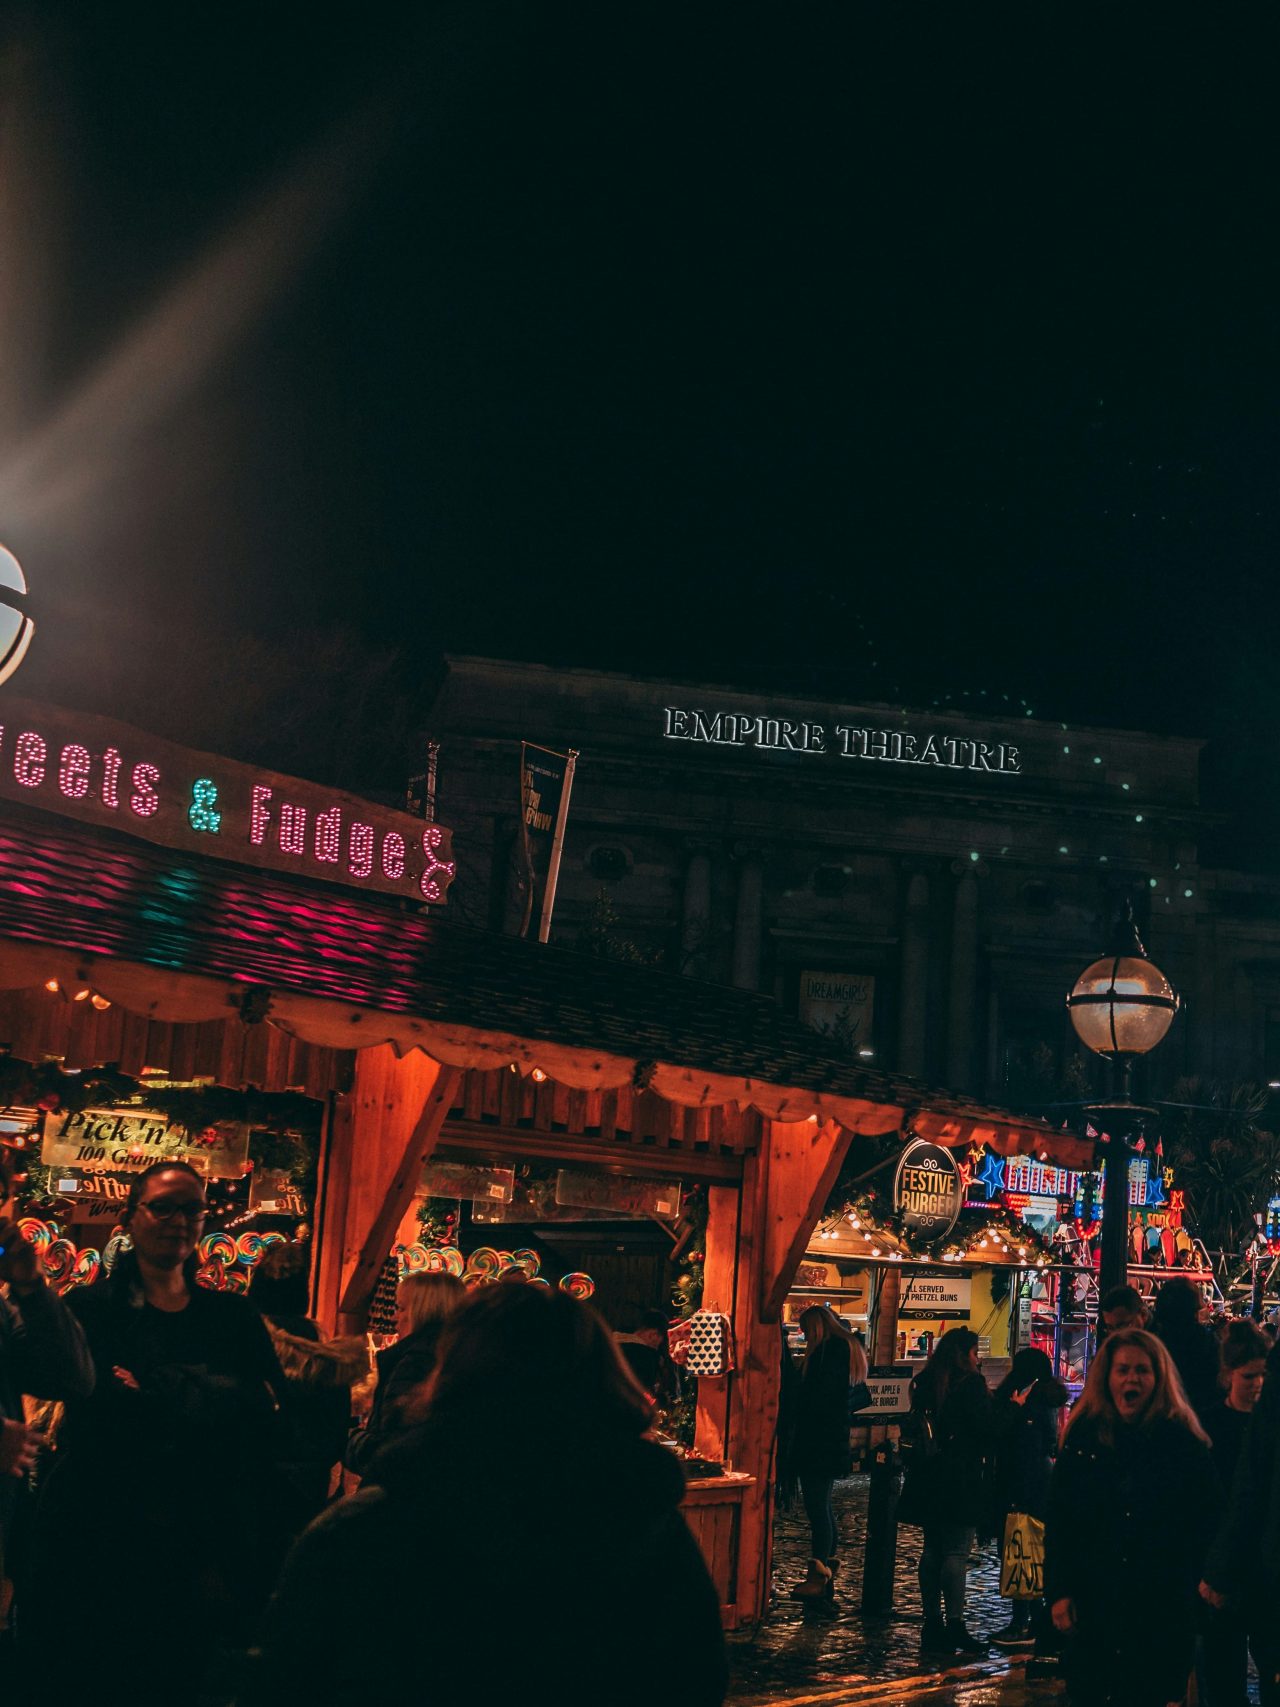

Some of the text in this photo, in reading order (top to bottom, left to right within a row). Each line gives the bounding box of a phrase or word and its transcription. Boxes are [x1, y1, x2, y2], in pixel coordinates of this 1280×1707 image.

[664, 707, 1022, 774] EMPIRE THEATRE
[0, 726, 161, 819] eets
[188, 778, 222, 834] &
[250, 783, 406, 880] Fudge
[807, 978, 867, 1002] DREAMGIRLS
[57, 1109, 131, 1143] Pick
[903, 1168, 956, 1195] FESTIVE
[901, 1190, 955, 1216] BURGER
[911, 1293, 939, 1301] PRETZEL
[940, 1293, 958, 1302] BUNS
[919, 1285, 944, 1293] SERVED
[880, 1397, 899, 1406] BURGER
[881, 1385, 896, 1394] APPLE
